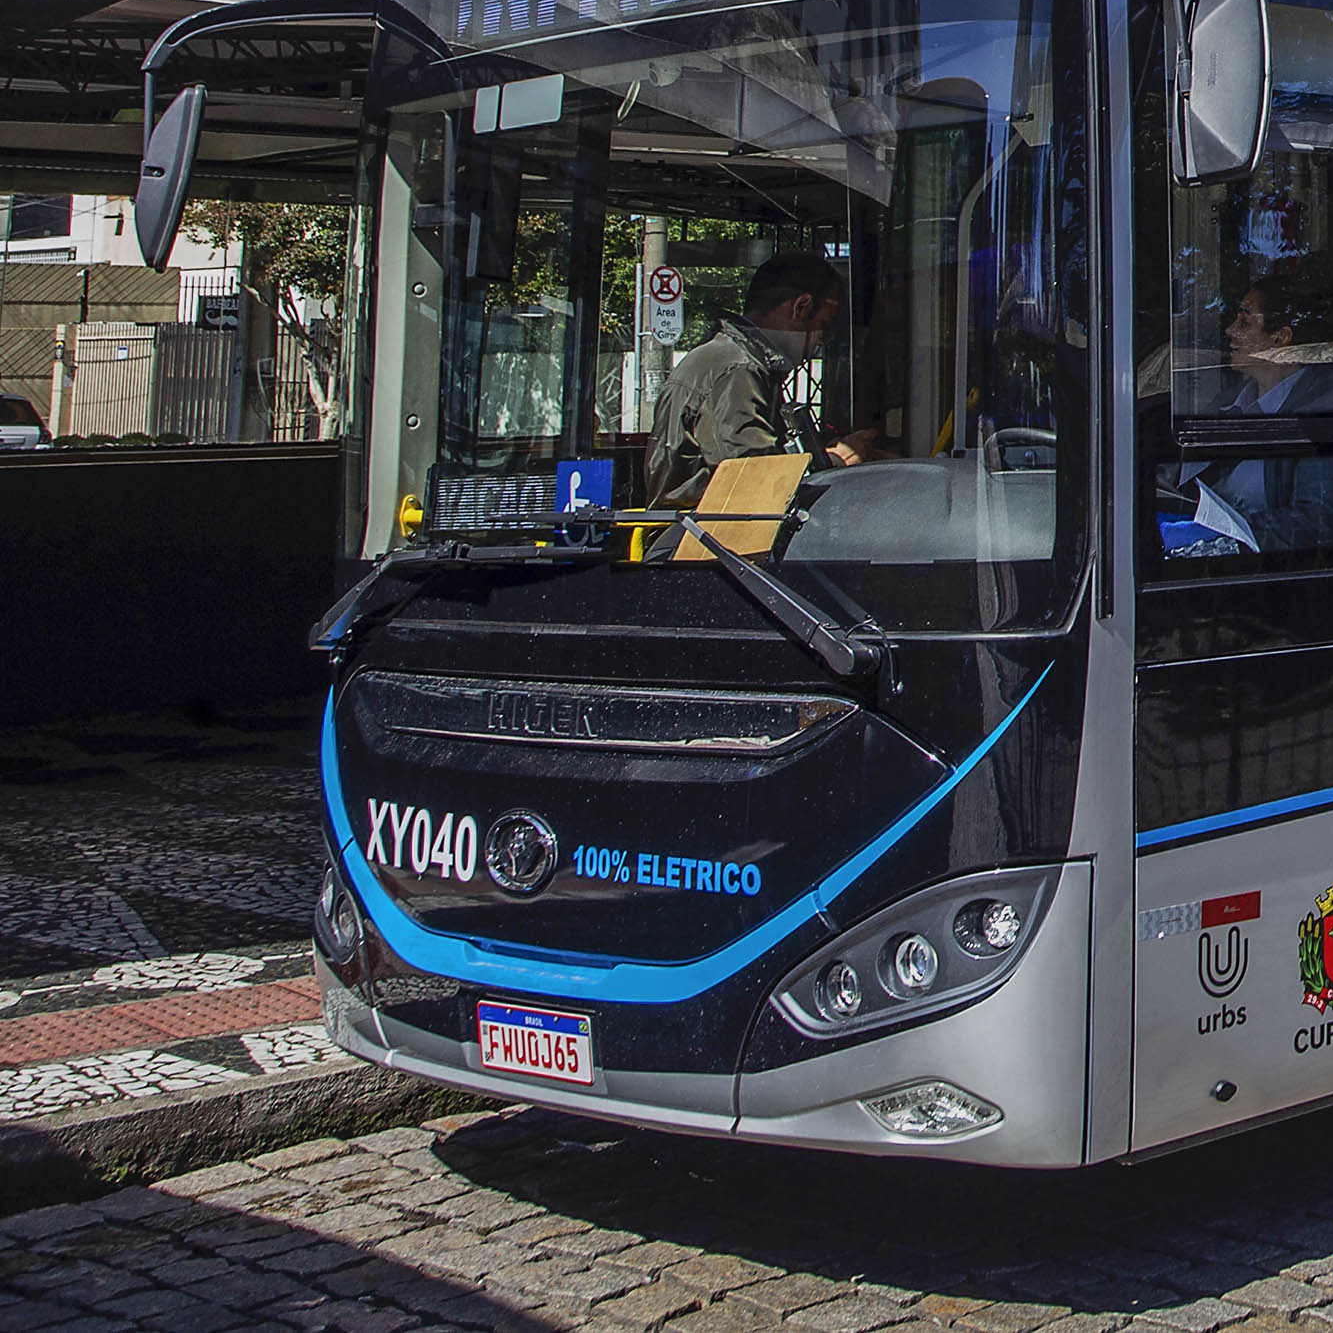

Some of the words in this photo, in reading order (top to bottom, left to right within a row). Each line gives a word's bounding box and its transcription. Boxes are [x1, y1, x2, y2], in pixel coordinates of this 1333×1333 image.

[661, 319, 671, 327] de
[366, 797, 478, 882] XY040
[572, 844, 630, 883] 100%
[636, 852, 762, 897] ELETRICO
[525, 1016, 544, 1027] BRASIL
[1198, 1004, 1247, 1035] urbs
